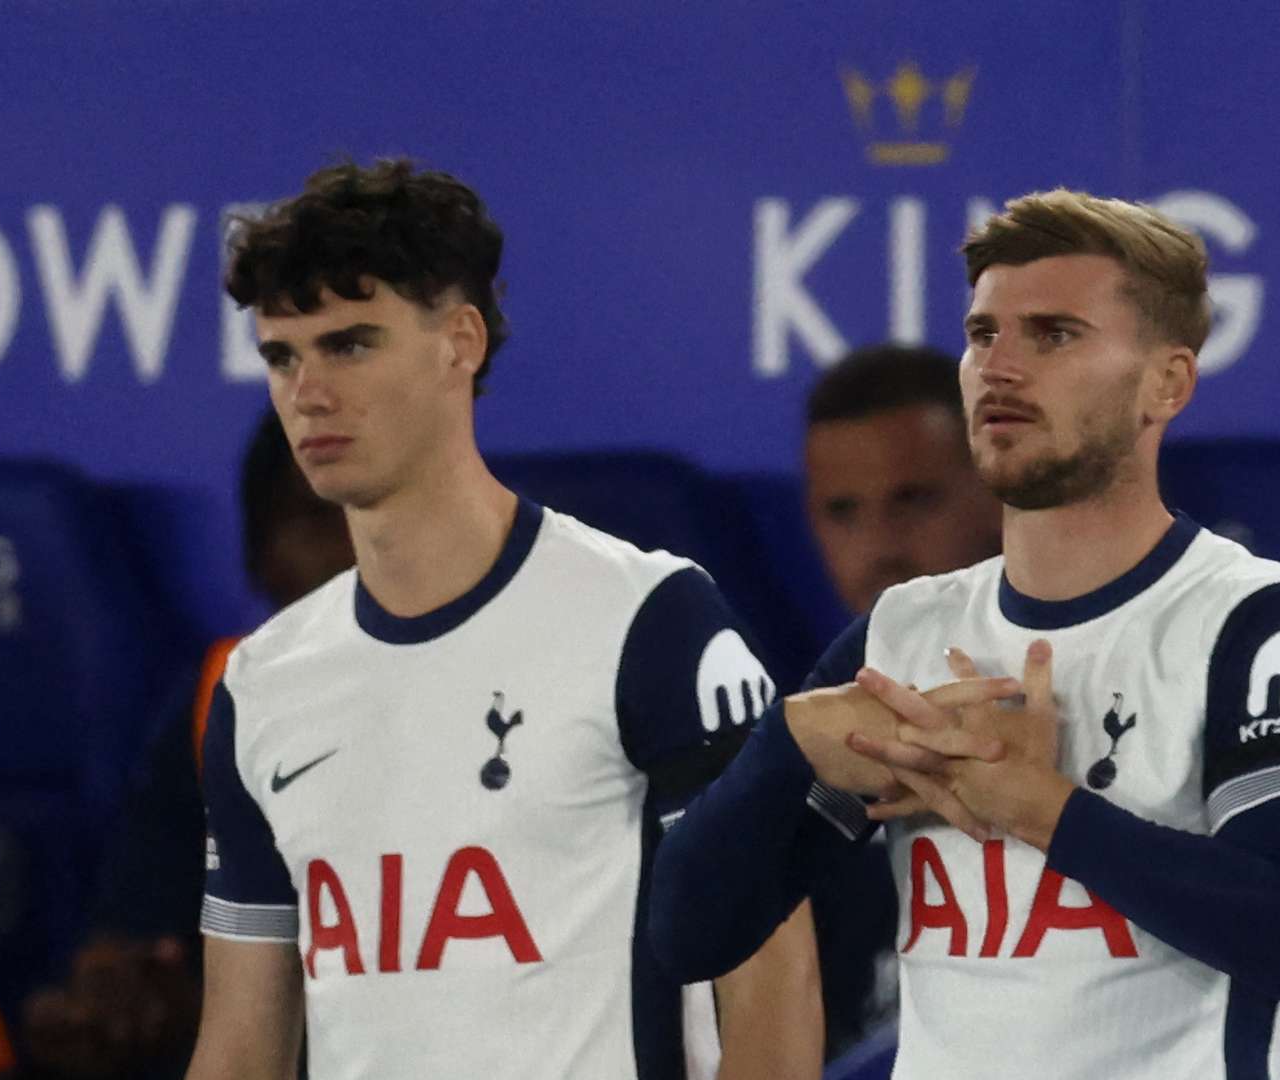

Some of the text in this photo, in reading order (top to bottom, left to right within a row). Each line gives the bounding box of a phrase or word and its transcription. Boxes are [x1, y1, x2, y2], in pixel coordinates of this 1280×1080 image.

[751, 188, 1265, 378] KIG
[306, 845, 544, 980] AIA
[899, 836, 1140, 959] AIA
